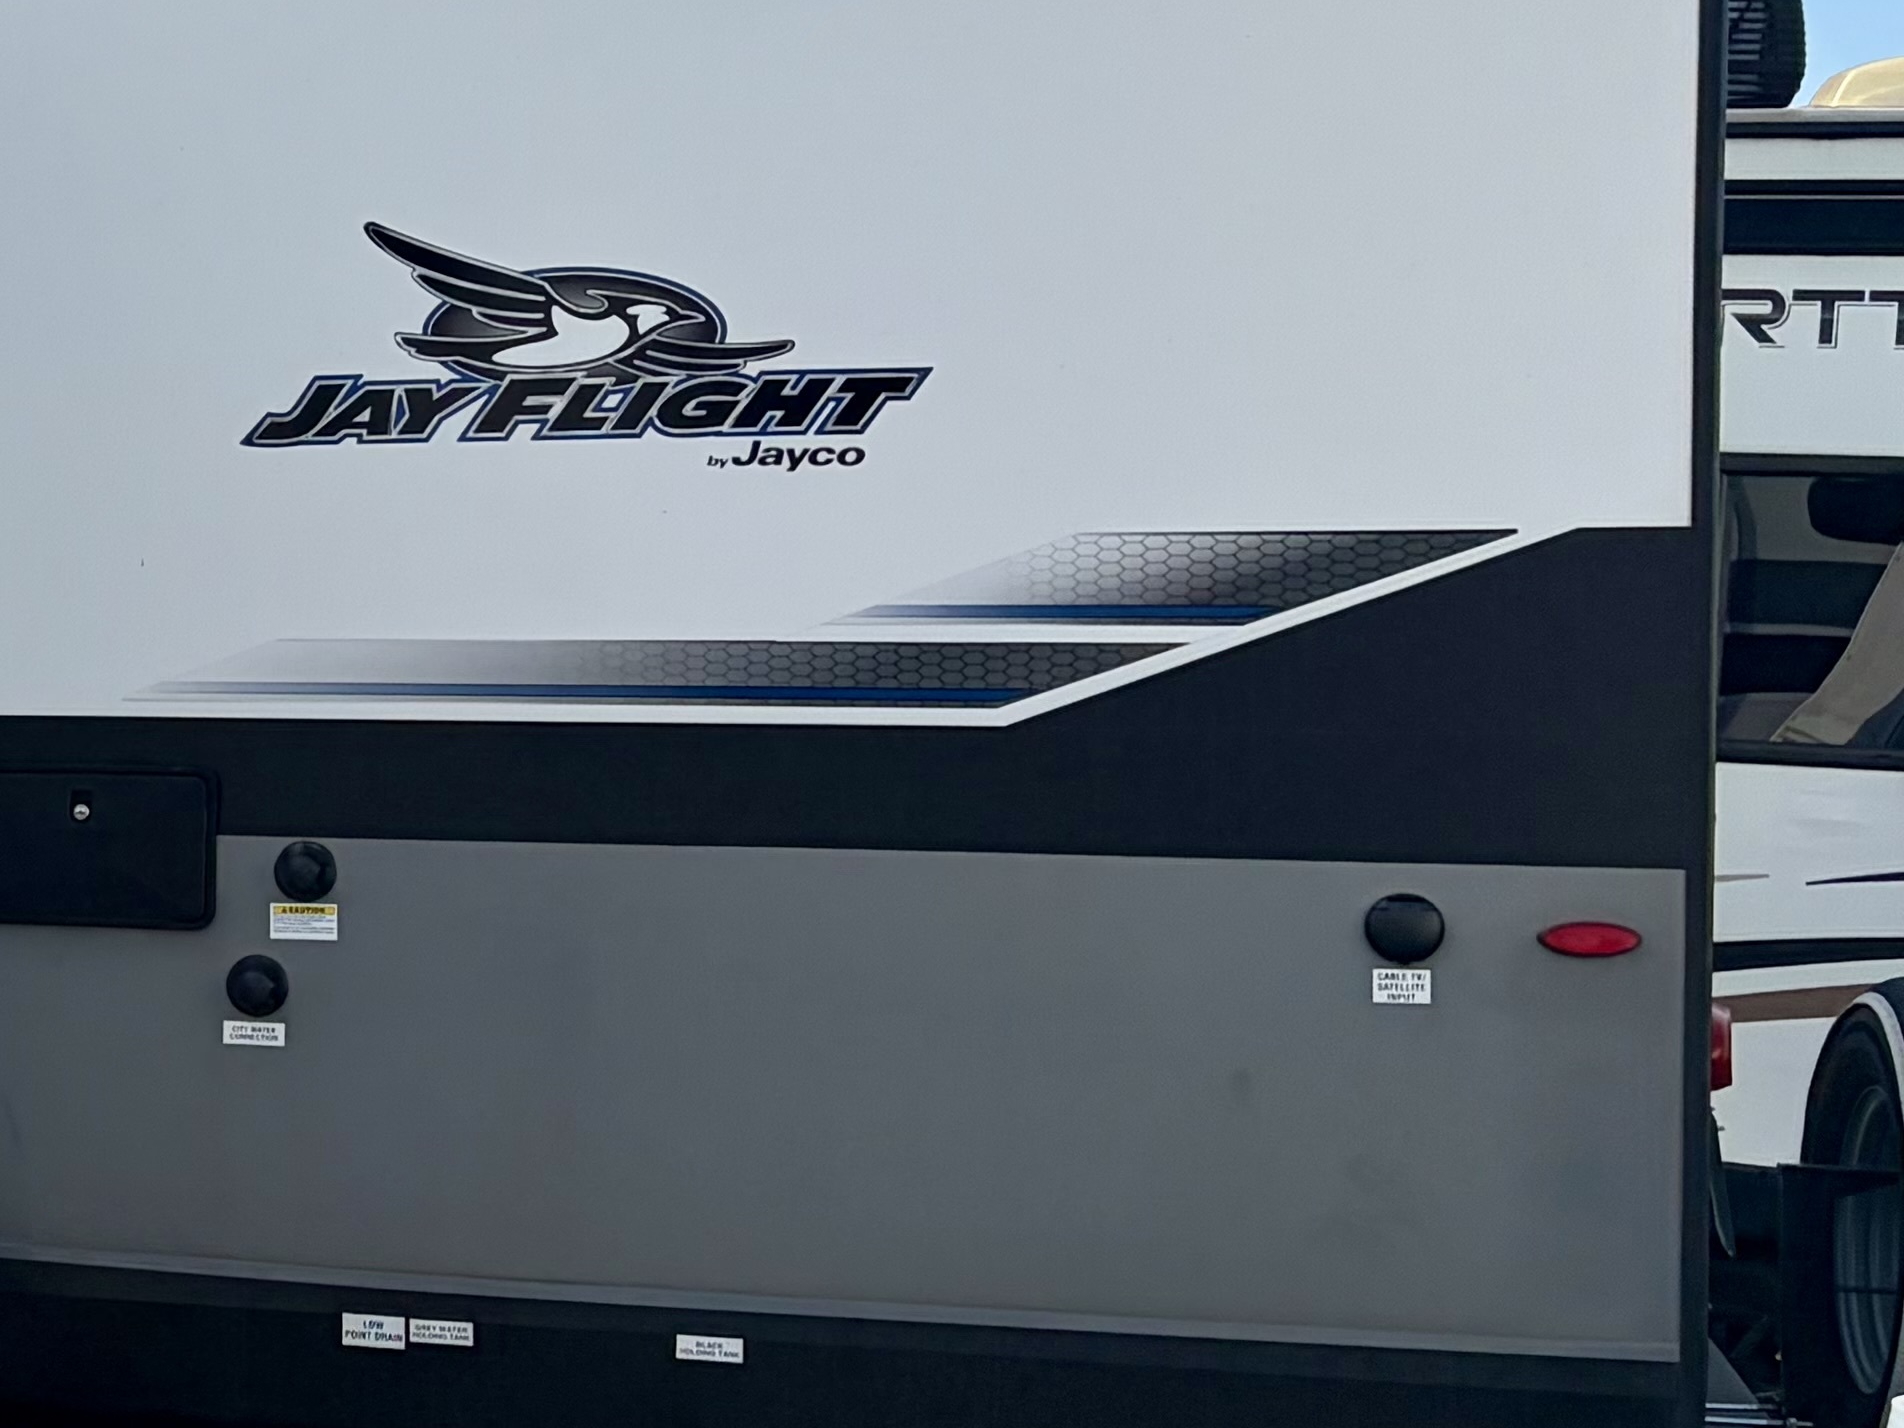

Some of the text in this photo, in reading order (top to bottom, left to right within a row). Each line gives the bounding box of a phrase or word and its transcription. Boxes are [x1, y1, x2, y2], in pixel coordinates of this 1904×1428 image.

[240, 367, 933, 447] JAY FLIGHT
[706, 440, 866, 472] by Jayco
[1377, 972, 1406, 981] CABLE
[1377, 982, 1425, 992] SATELLITE
[1387, 993, 1415, 1002] INPUT
[251, 1026, 276, 1034] WATER
[363, 1320, 384, 1330] LOW
[438, 1325, 468, 1333] WATER
[345, 1329, 403, 1343] POINT DRAIN
[412, 1332, 470, 1342] HOLDING TANK
[695, 1341, 723, 1350] BLACK
[679, 1347, 739, 1358] HOLDING TANK
